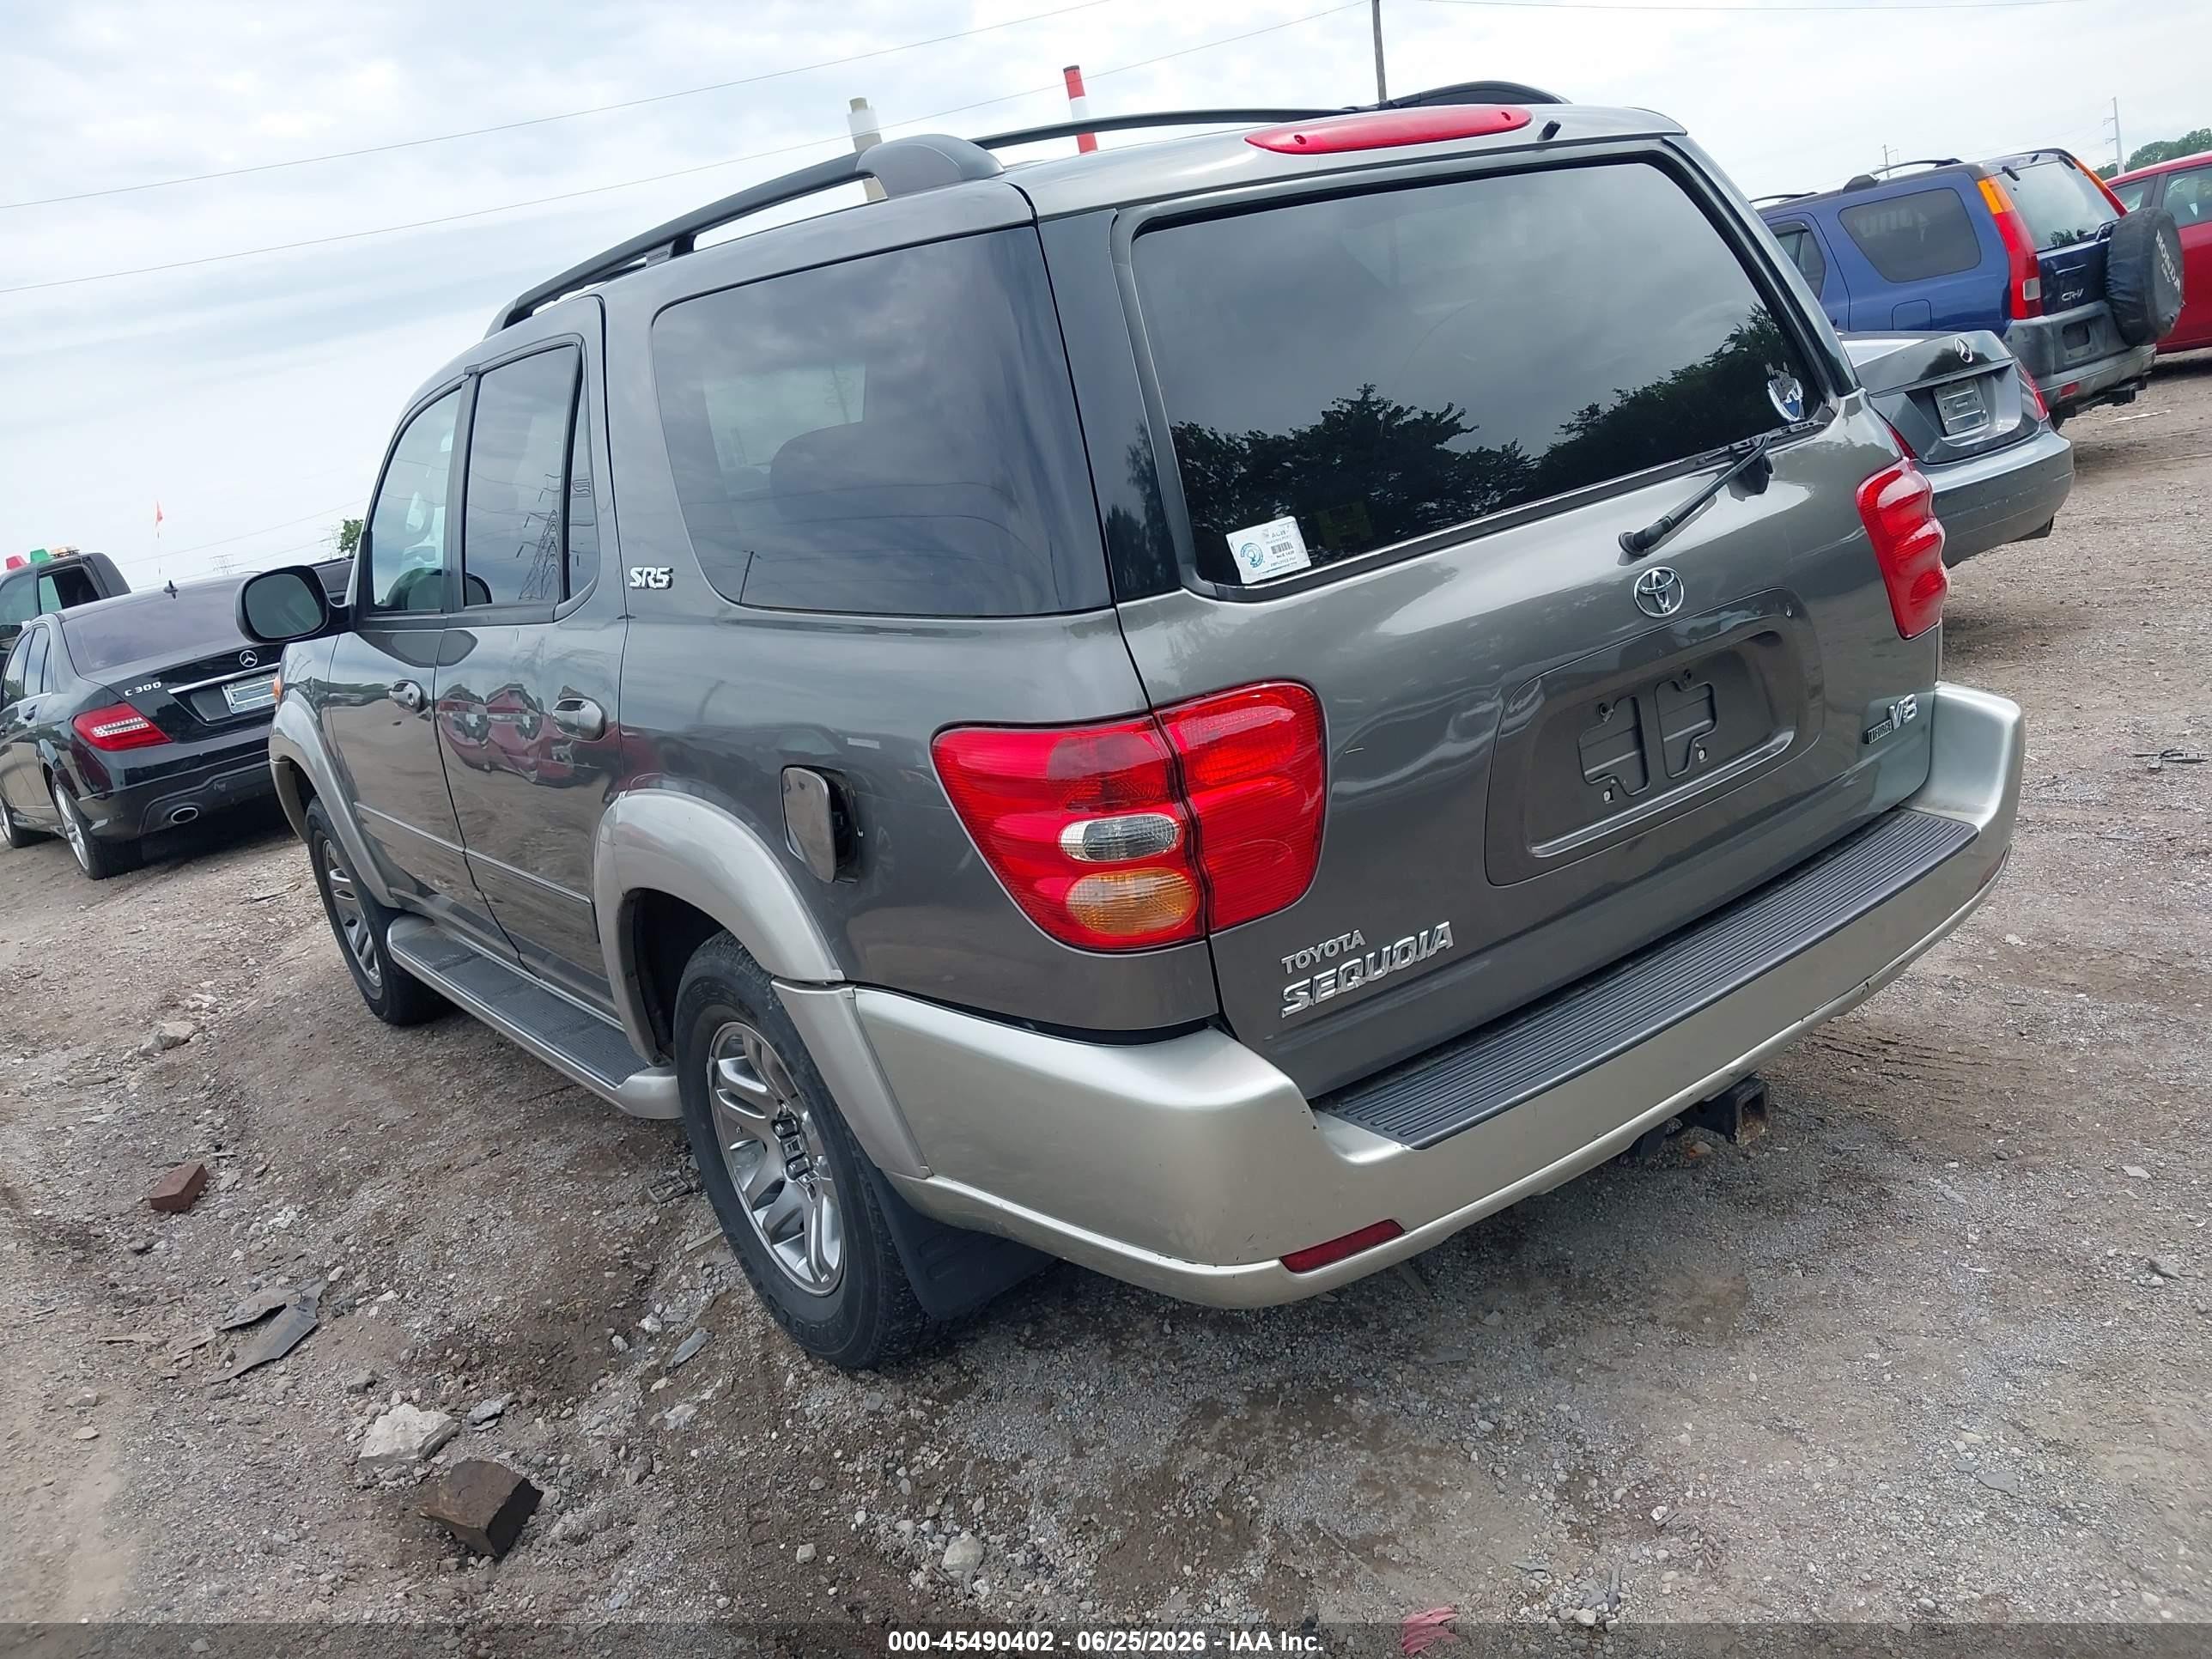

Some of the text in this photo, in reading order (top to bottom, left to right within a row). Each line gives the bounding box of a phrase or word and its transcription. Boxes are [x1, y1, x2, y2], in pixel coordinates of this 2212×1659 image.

[2155, 228, 2180, 293] HONDA
[629, 566, 673, 590] SR5
[135, 681, 162, 694] 300
[1888, 693, 1917, 730] V8
[1280, 929, 1366, 975] TOYOTA
[1280, 921, 1455, 1018] SEQUOIA
